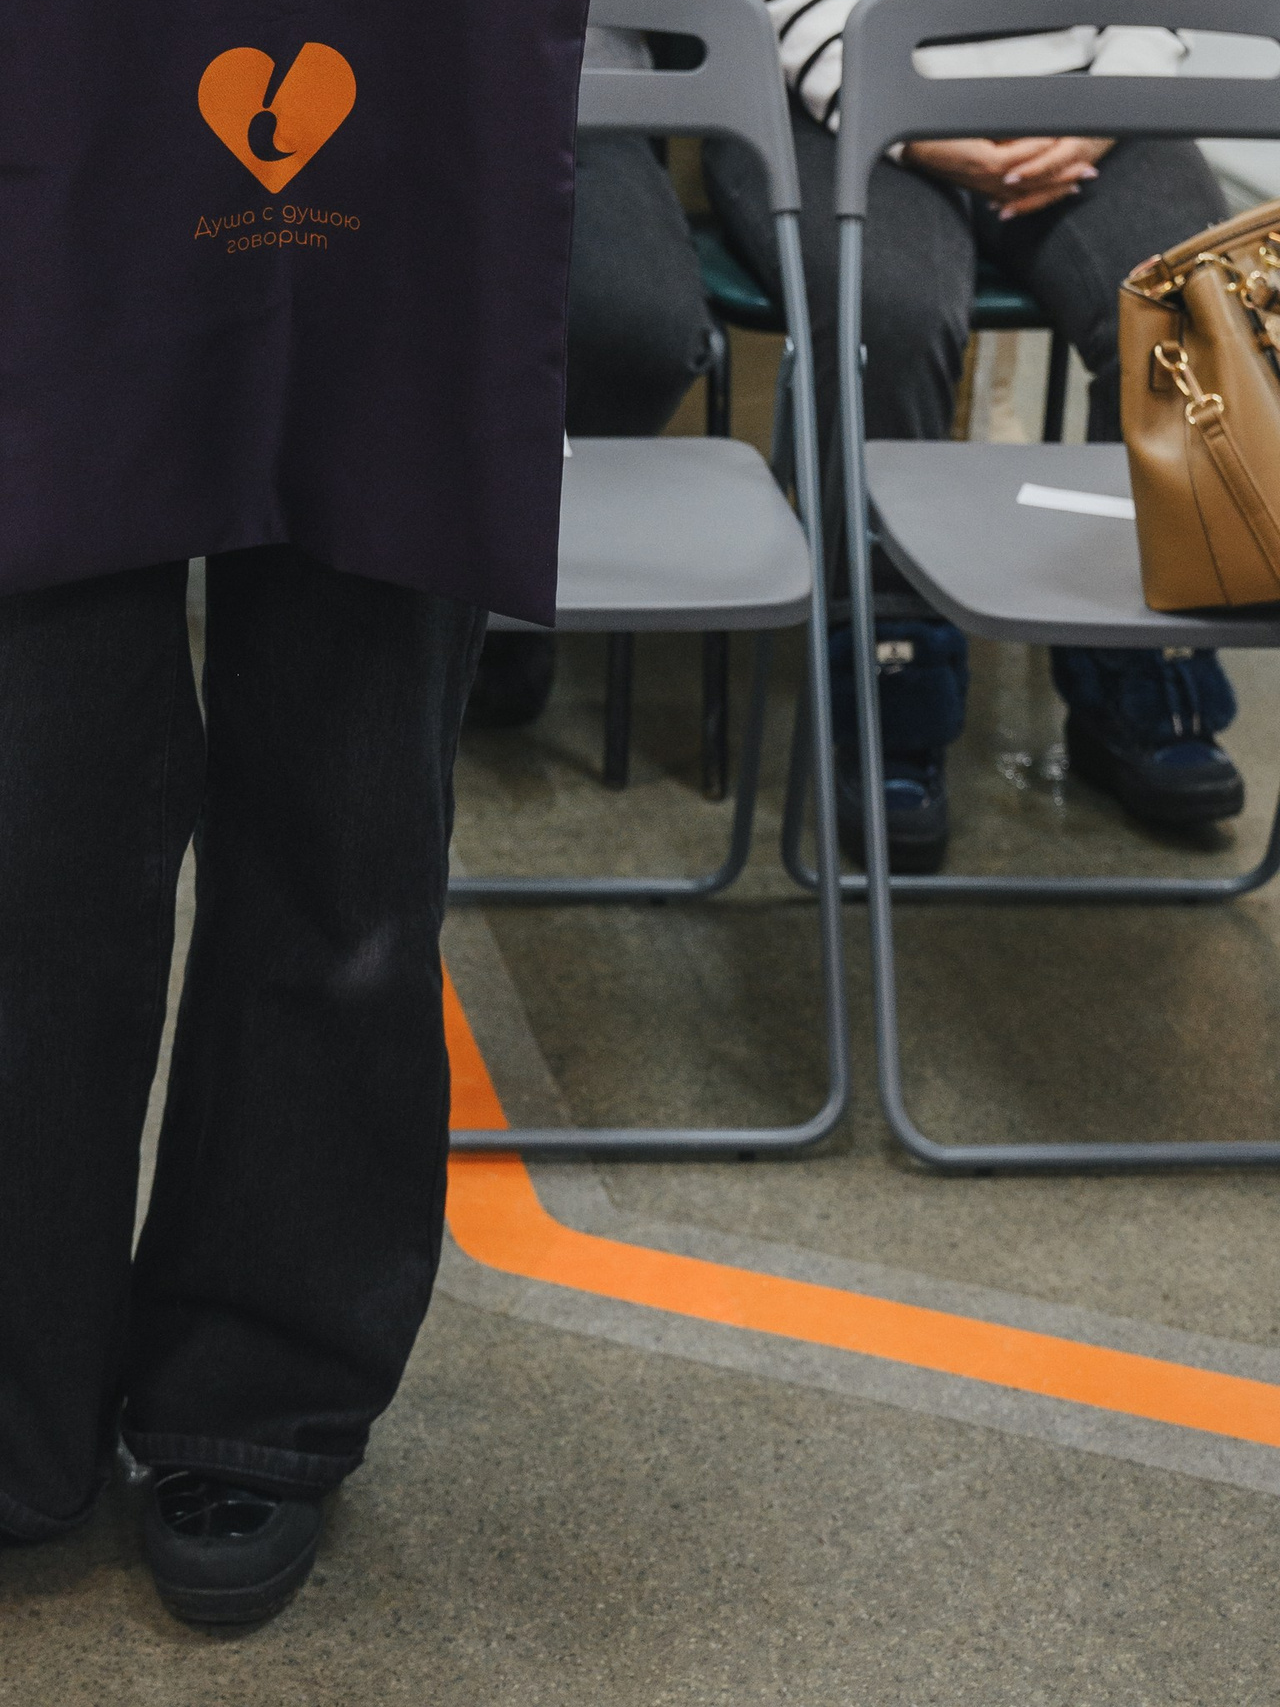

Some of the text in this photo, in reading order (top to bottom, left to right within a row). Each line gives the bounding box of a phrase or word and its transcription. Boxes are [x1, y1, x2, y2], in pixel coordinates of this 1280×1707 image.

[194, 204, 361, 240] Душа с душою
[227, 229, 328, 254] говорит
